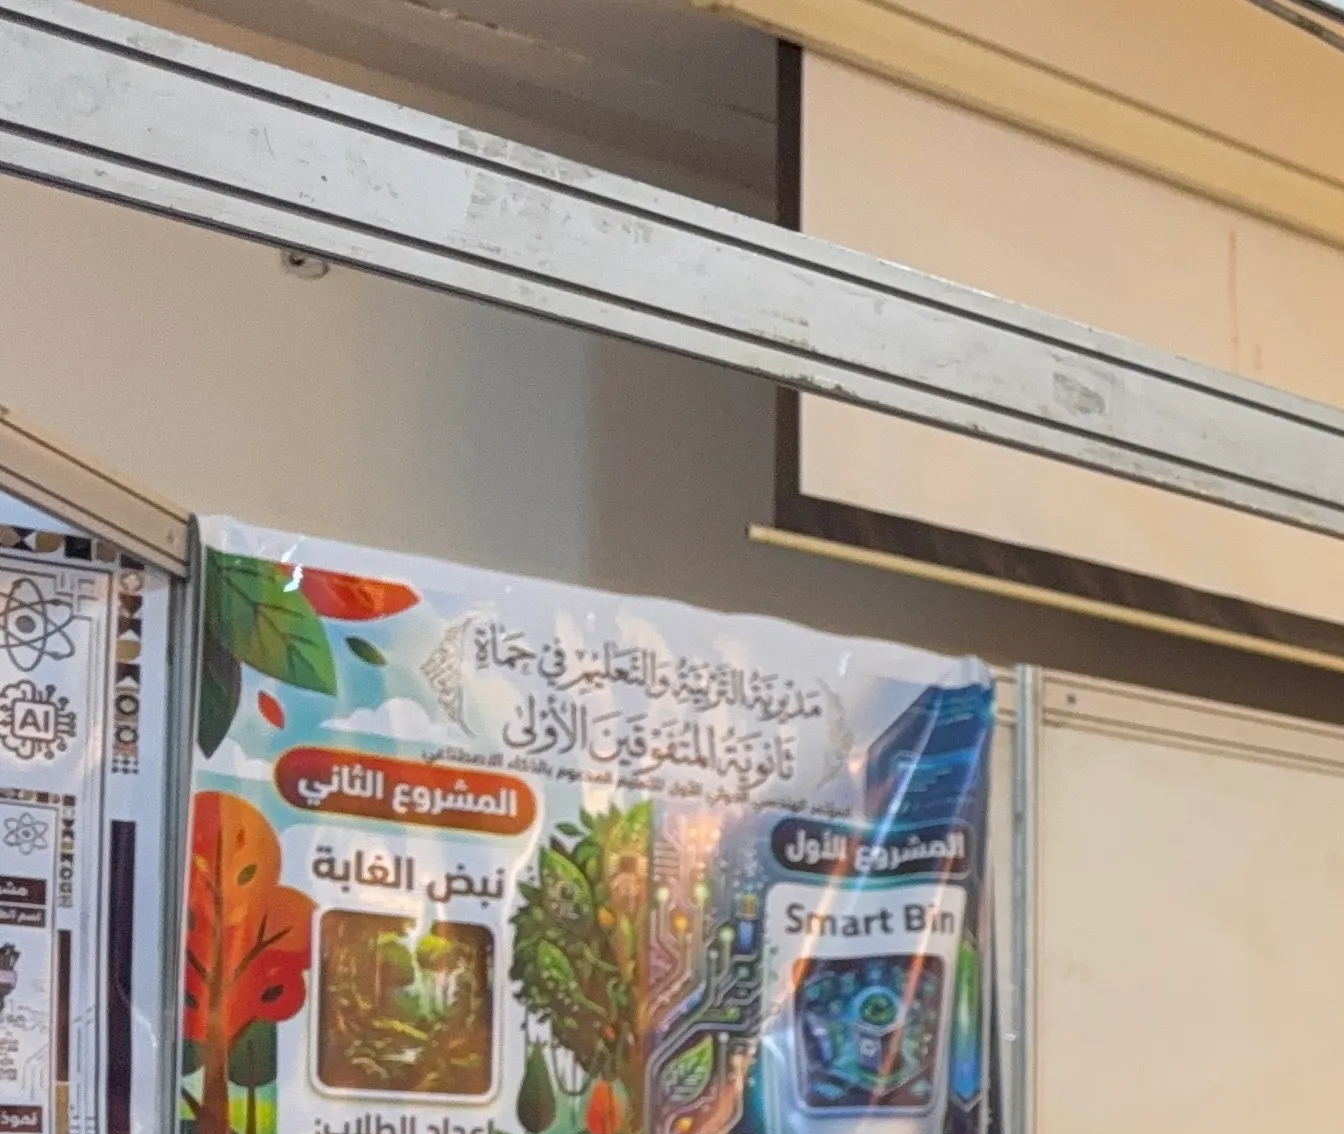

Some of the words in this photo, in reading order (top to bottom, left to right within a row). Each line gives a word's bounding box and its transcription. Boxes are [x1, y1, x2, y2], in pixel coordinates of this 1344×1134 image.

[537, 637, 567, 687] في
[18, 708, 50, 736] AI
[297, 763, 385, 806] الثاني
[391, 778, 519, 818] المشروع
[783, 828, 848, 865] الأول
[853, 831, 966, 873] المشروع
[312, 845, 414, 892] الغابة
[425, 862, 506, 909] نبض
[785, 902, 894, 937] Smart
[903, 902, 955, 935] Bin
[0, 1109, 38, 1129] نموذ
